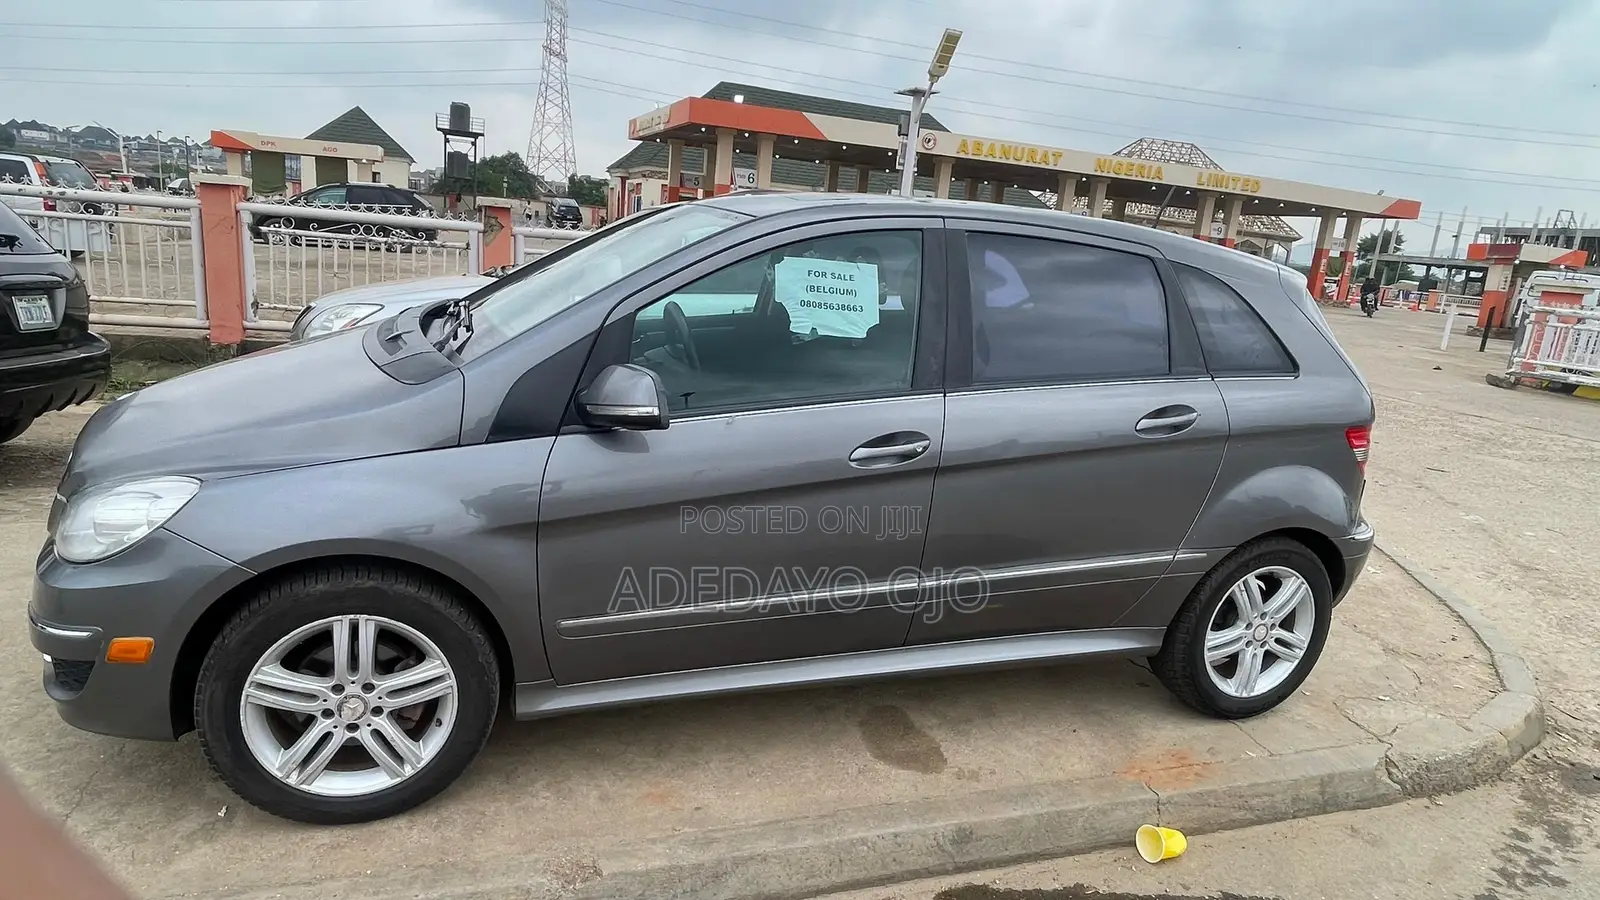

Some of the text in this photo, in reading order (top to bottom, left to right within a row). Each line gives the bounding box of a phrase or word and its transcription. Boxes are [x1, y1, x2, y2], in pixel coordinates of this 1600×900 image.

[260, 140, 277, 149] DPK
[956, 138, 1262, 193] ABANURAT NIGERIA LIMITED
[693, 175, 700, 187] 5
[747, 172, 755, 184] 6
[1216, 226, 1223, 235] 9
[807, 270, 855, 282] FOR SALE
[805, 284, 857, 298] (BELGIUM)
[799, 299, 864, 313] 08085638663
